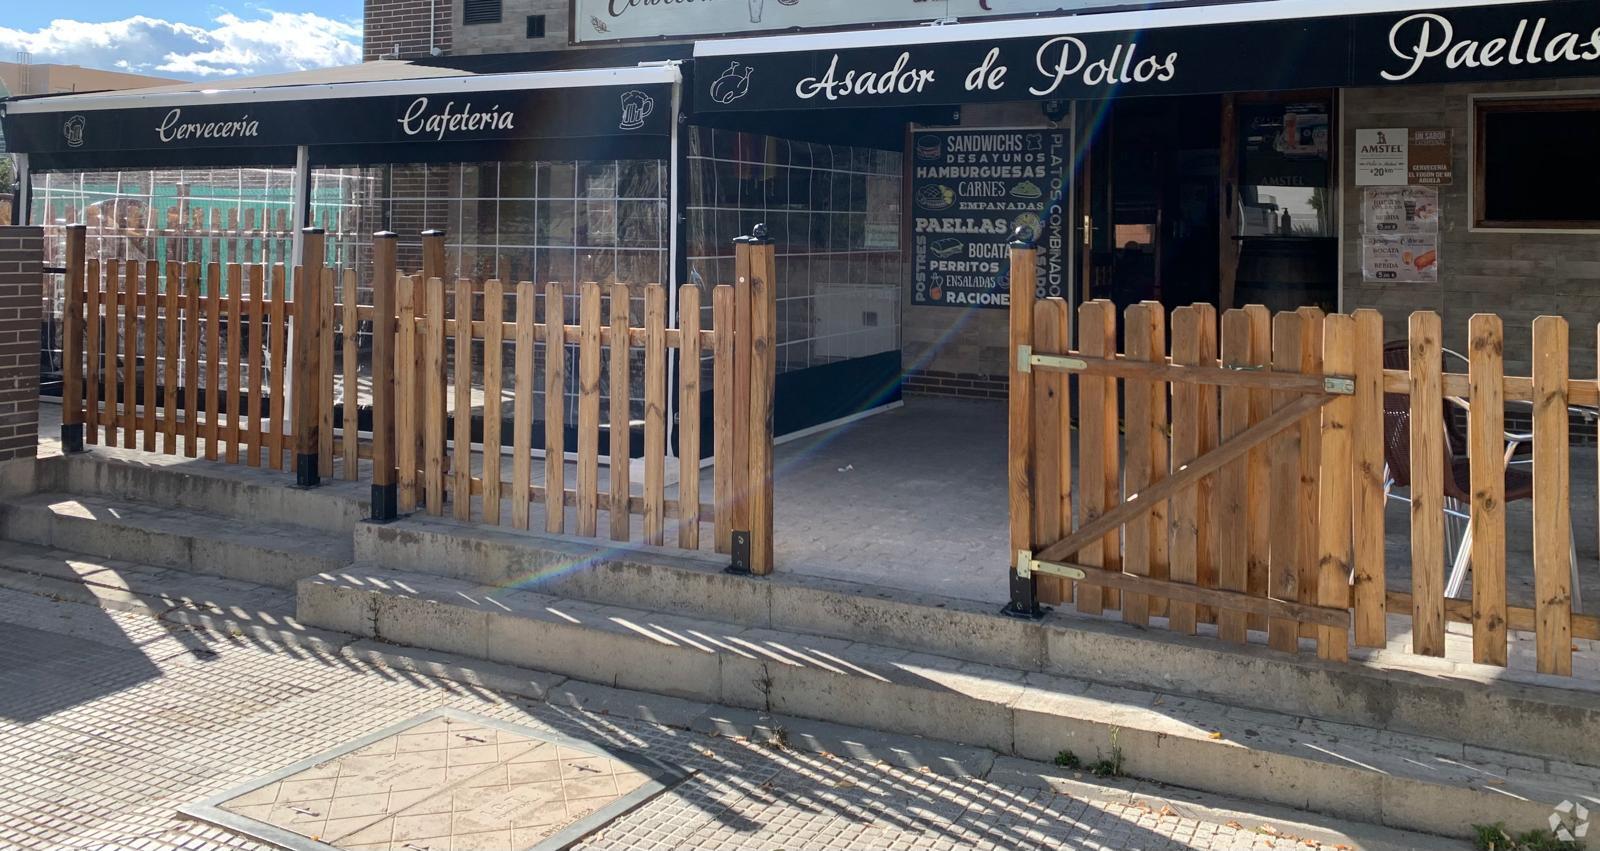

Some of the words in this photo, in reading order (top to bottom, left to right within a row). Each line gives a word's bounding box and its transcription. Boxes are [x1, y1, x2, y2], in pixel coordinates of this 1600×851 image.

[1380, 12, 1600, 81] Paellas
[795, 53, 936, 101] Asador
[965, 47, 1007, 92] de
[1029, 36, 1178, 97] Pollos
[155, 107, 259, 143] Cervecería
[398, 96, 515, 141] Cafetería
[947, 134, 1023, 152] SANDWICHS
[1360, 144, 1403, 153] AMSTEL
[946, 153, 1046, 164] DESAYUNOS
[916, 166, 1046, 179] HAMBURGUESAS
[1050, 133, 1063, 201] PLATOS
[1262, 175, 1305, 186] AMSTEL
[958, 181, 1006, 197] CARNES
[959, 202, 1044, 211] EMPANADAS
[915, 218, 1008, 234] PAELLAS
[968, 243, 1011, 259] BOCATA
[1048, 204, 1062, 297] COMBINADO
[915, 235, 927, 302] POSTRES
[929, 261, 1000, 273] PERRITOS
[1036, 245, 1047, 299] ASADO
[946, 275, 996, 289] ENSALADAS
[946, 291, 1011, 305] RACIONE
